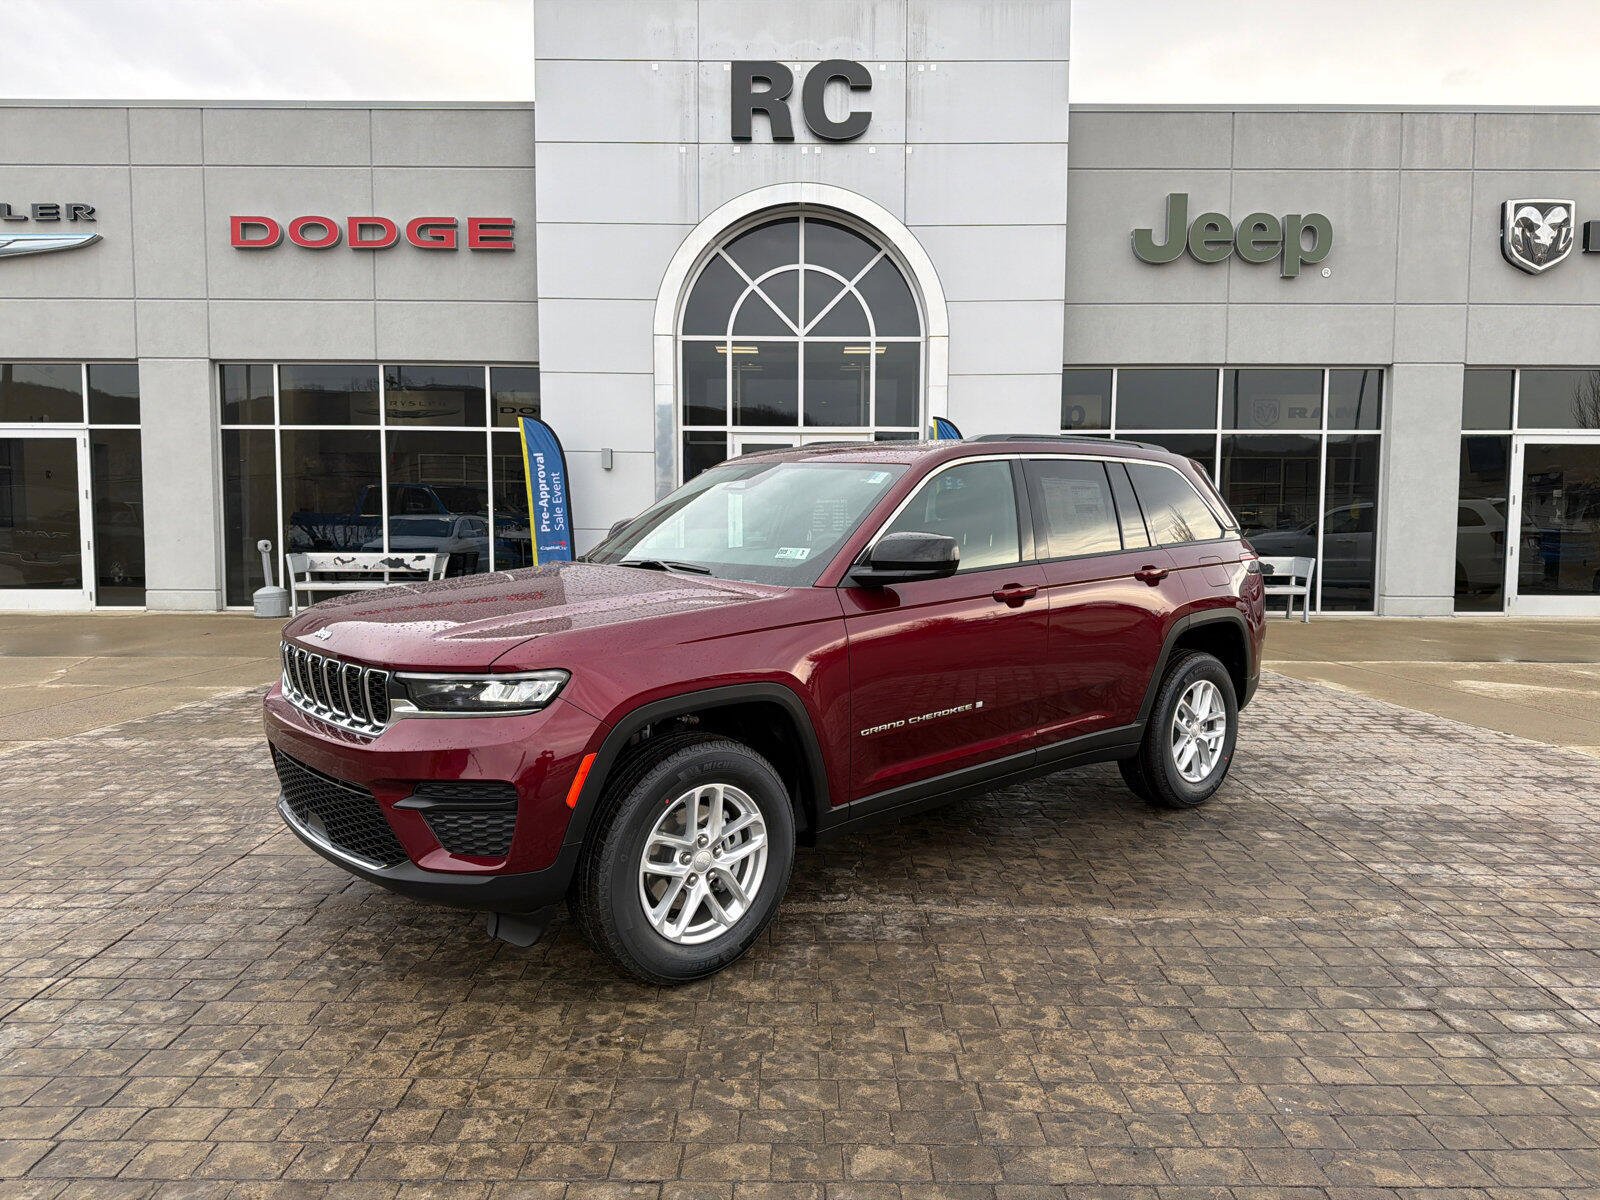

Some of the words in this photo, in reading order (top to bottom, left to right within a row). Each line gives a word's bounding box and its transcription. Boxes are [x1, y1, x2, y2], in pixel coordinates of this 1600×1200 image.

[731, 59, 873, 143] RC
[229, 216, 516, 251] DODGE
[1131, 193, 1334, 279] Jeep
[533, 452, 551, 533] Pre-Approval
[551, 471, 563, 504] Event
[554, 506, 566, 532] Sale
[860, 719, 906, 737] GRAND
[908, 703, 973, 725] CHEROKEE
